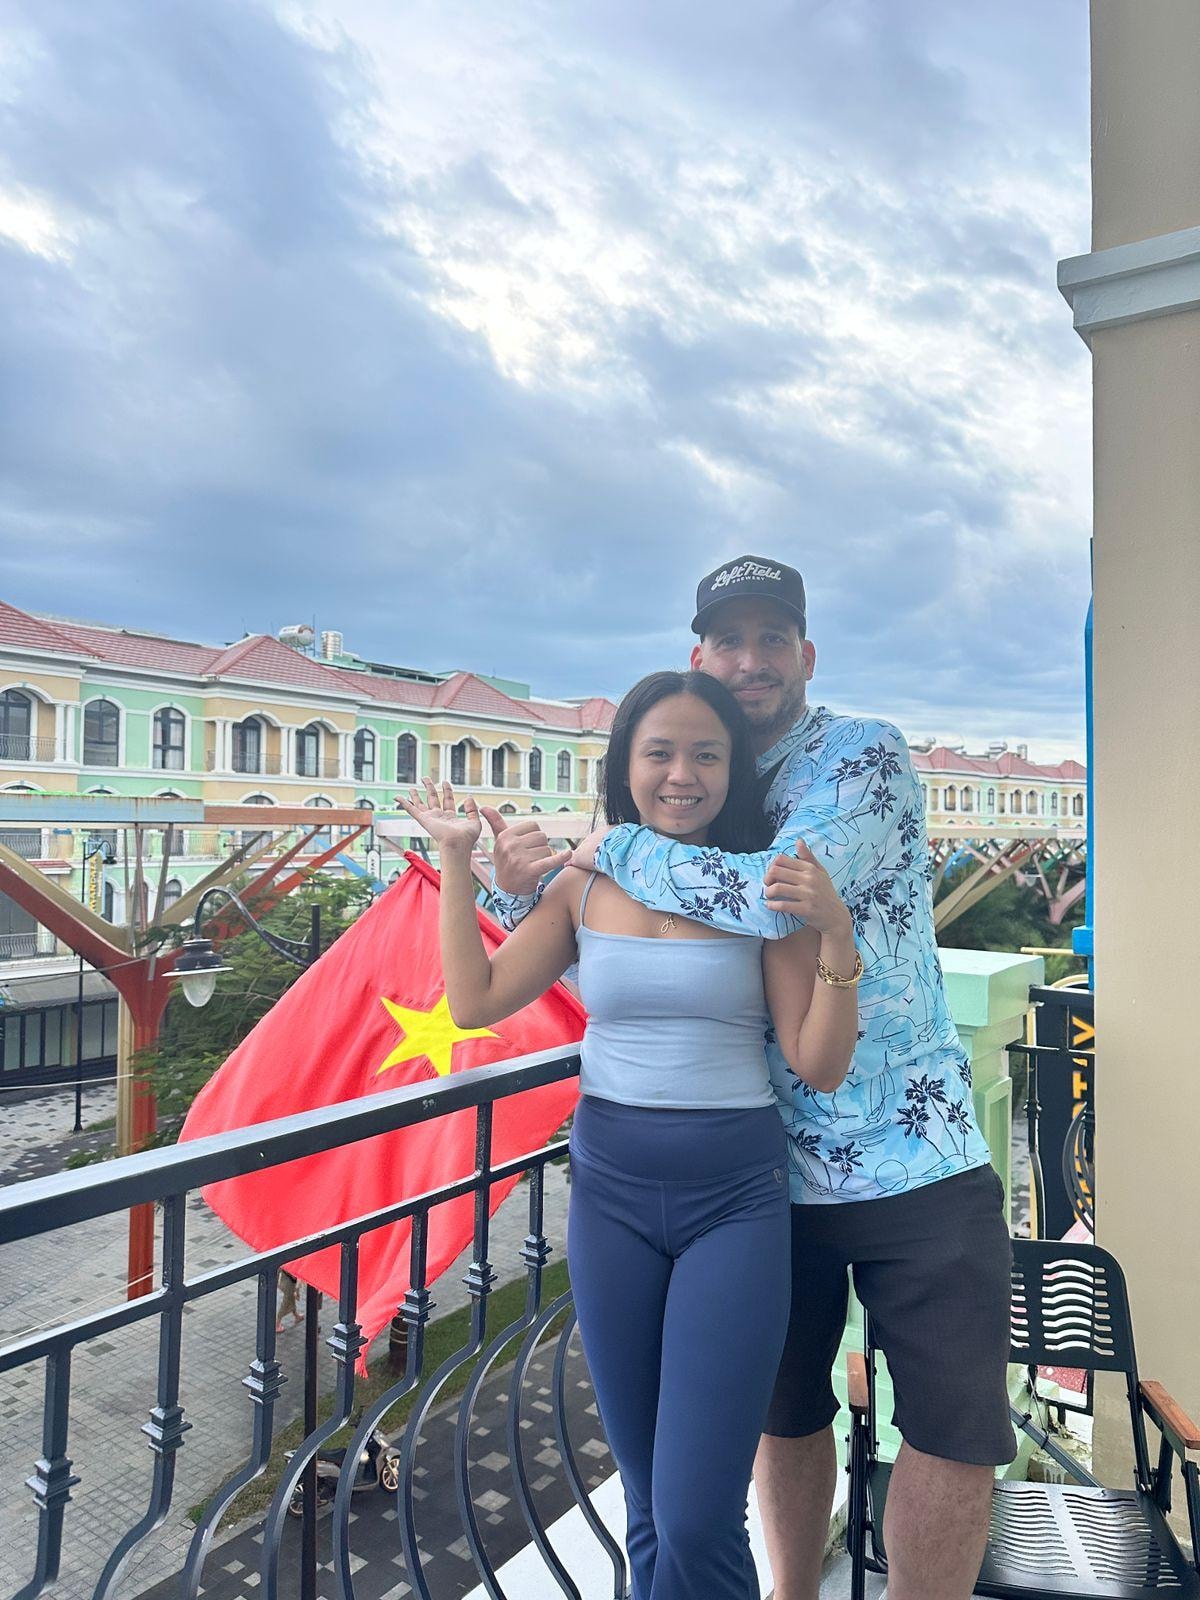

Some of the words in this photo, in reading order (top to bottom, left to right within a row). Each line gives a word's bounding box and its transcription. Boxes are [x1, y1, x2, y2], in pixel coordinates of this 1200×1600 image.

[711, 566, 745, 590] Left
[743, 561, 781, 580] Field
[732, 575, 765, 583] BREWERY
